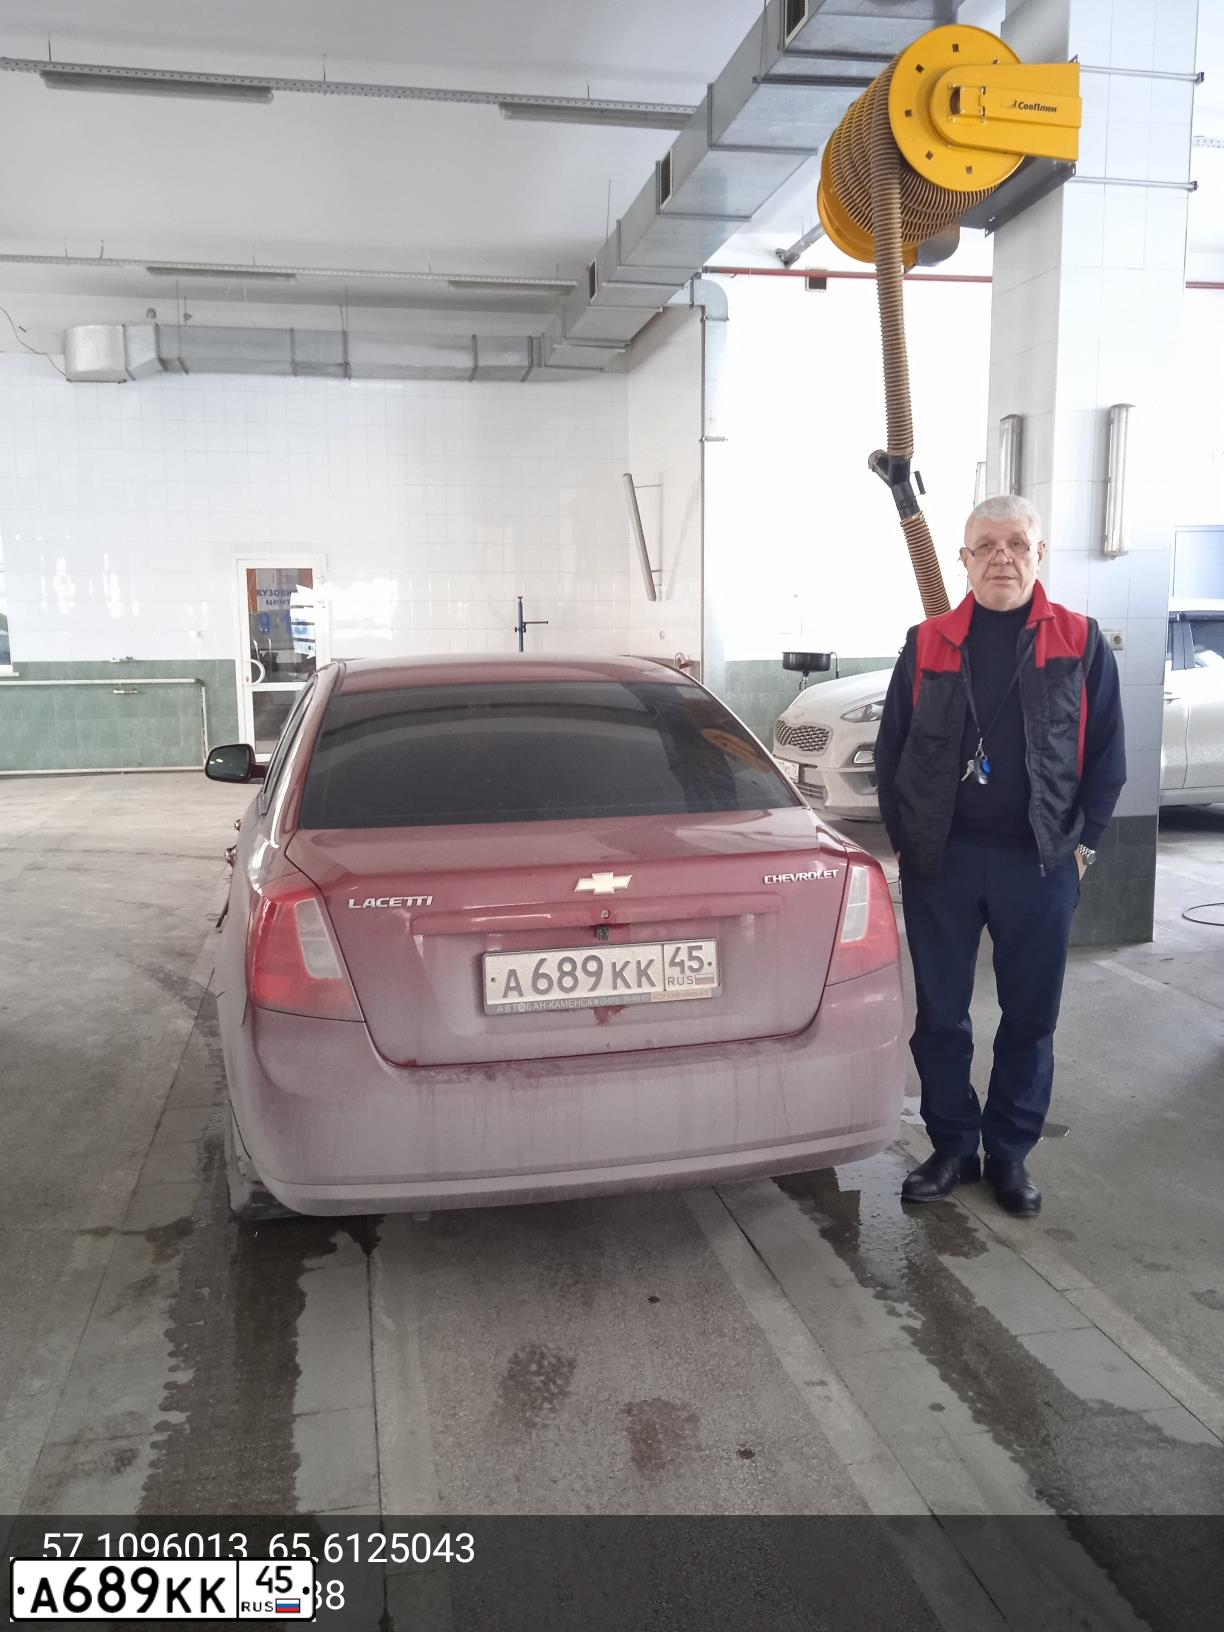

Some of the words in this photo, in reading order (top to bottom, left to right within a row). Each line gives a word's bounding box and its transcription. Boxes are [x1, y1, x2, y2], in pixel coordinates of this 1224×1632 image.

[1017, 101, 1057, 113] СовПлим
[764, 868, 839, 884] CHEVROLET
[348, 895, 433, 909] LACETTI
[668, 944, 705, 975] 45
[667, 974, 695, 987] RUS
